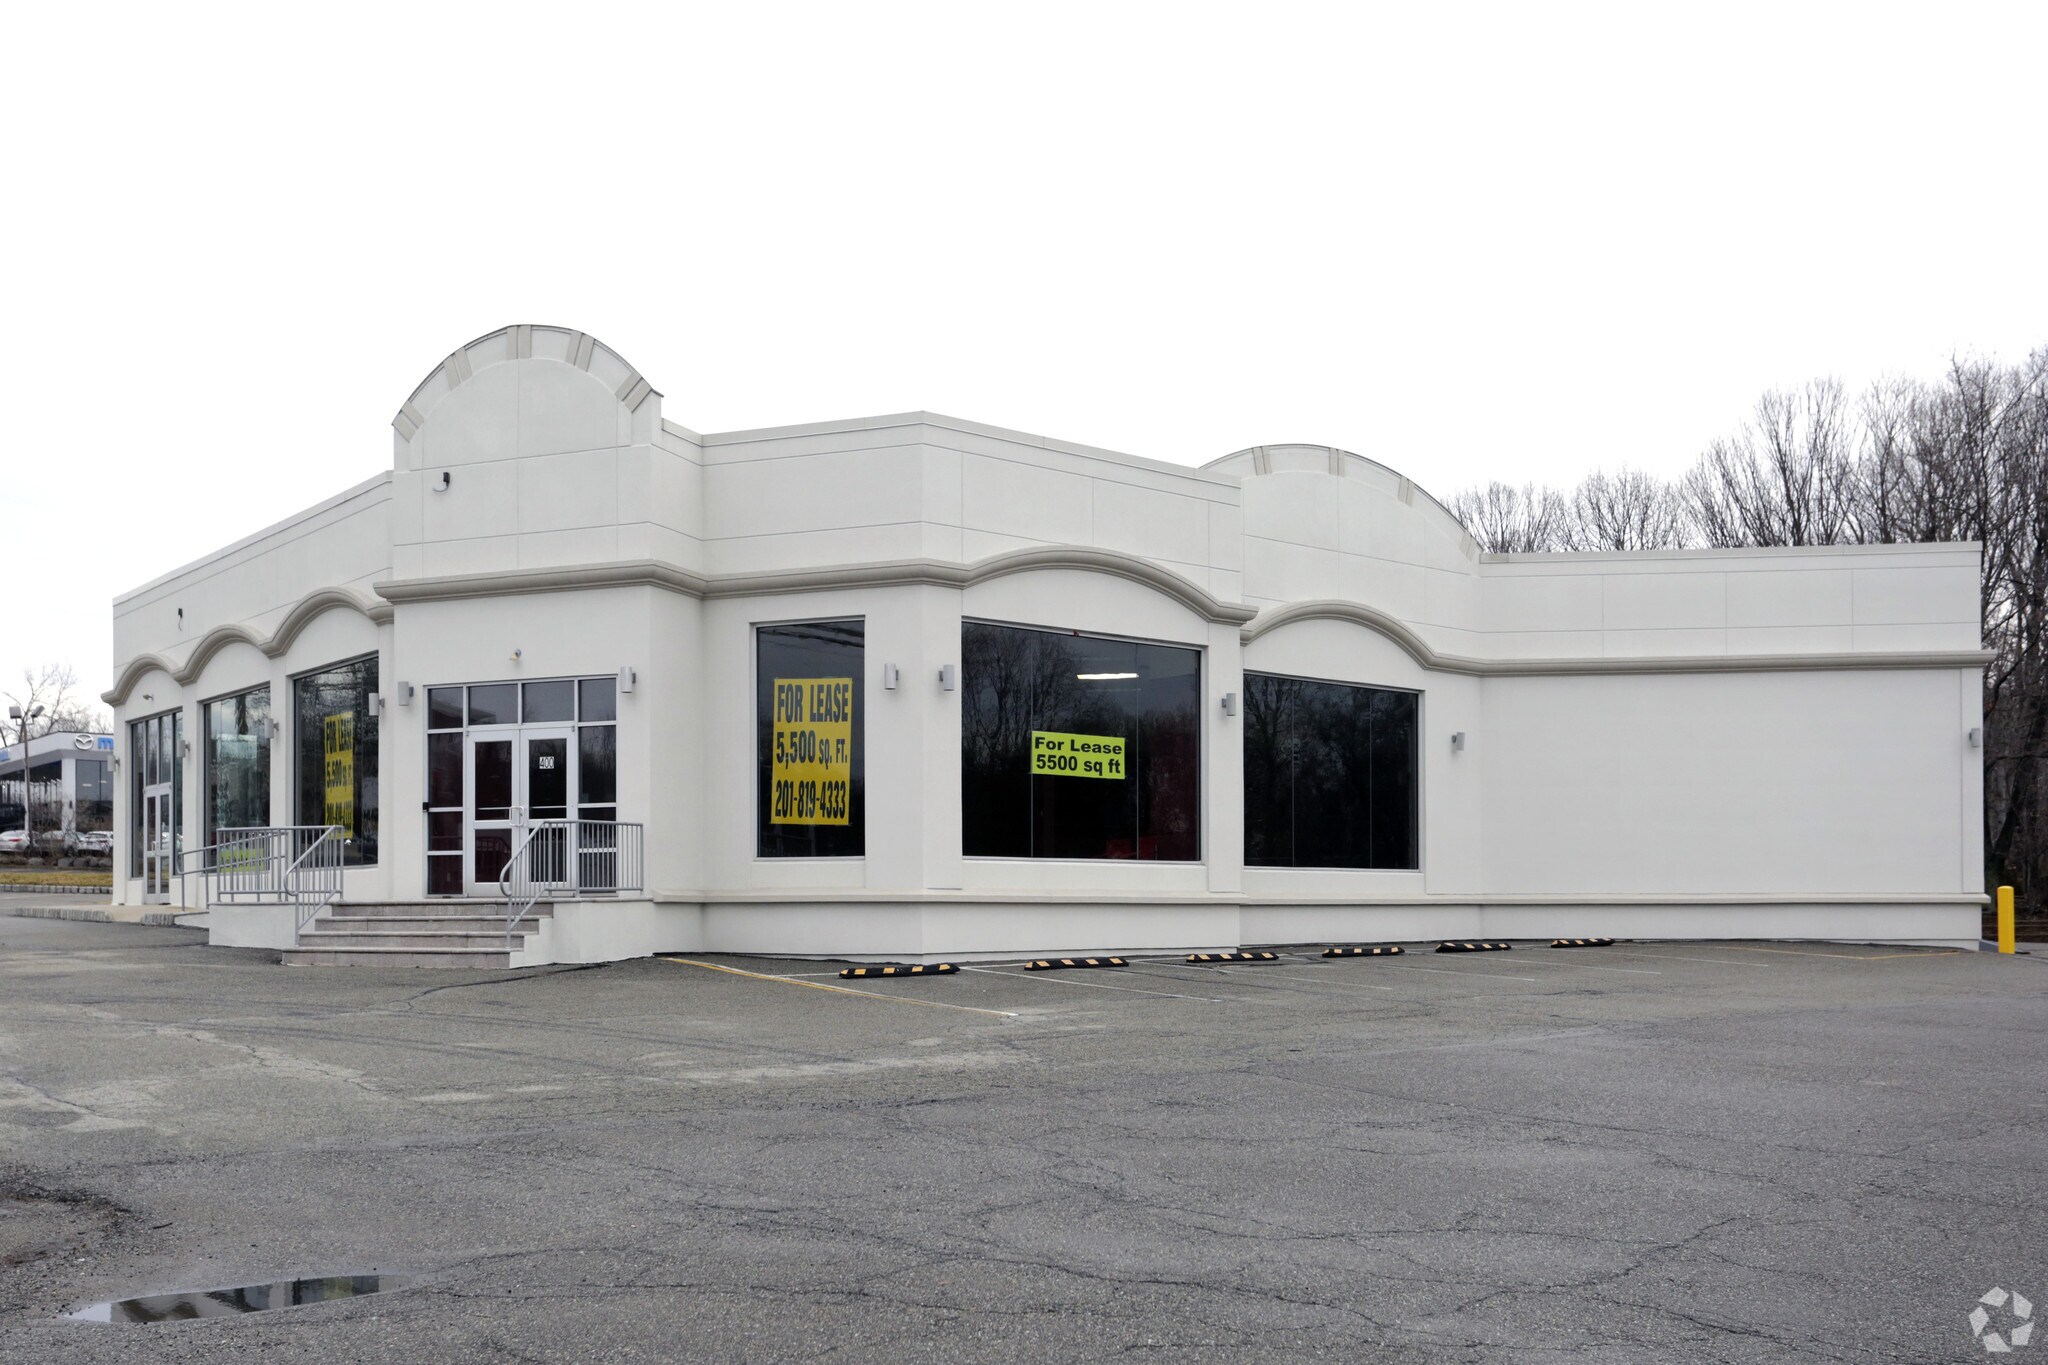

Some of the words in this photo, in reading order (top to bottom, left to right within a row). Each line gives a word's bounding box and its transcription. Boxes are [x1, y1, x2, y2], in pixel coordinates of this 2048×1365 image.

[777, 683, 804, 723] FOR
[810, 682, 849, 723] LEASE
[776, 730, 816, 770] 5,500
[819, 740, 833, 770] SQ.
[835, 738, 848, 764] FT.
[1035, 736, 1064, 751] For
[1070, 739, 1122, 755] Lease
[539, 756, 555, 769] 400
[1036, 754, 1078, 771] 5500
[1084, 760, 1103, 776] sq
[1108, 758, 1121, 774] ft
[775, 780, 847, 819] 201-819-4333
